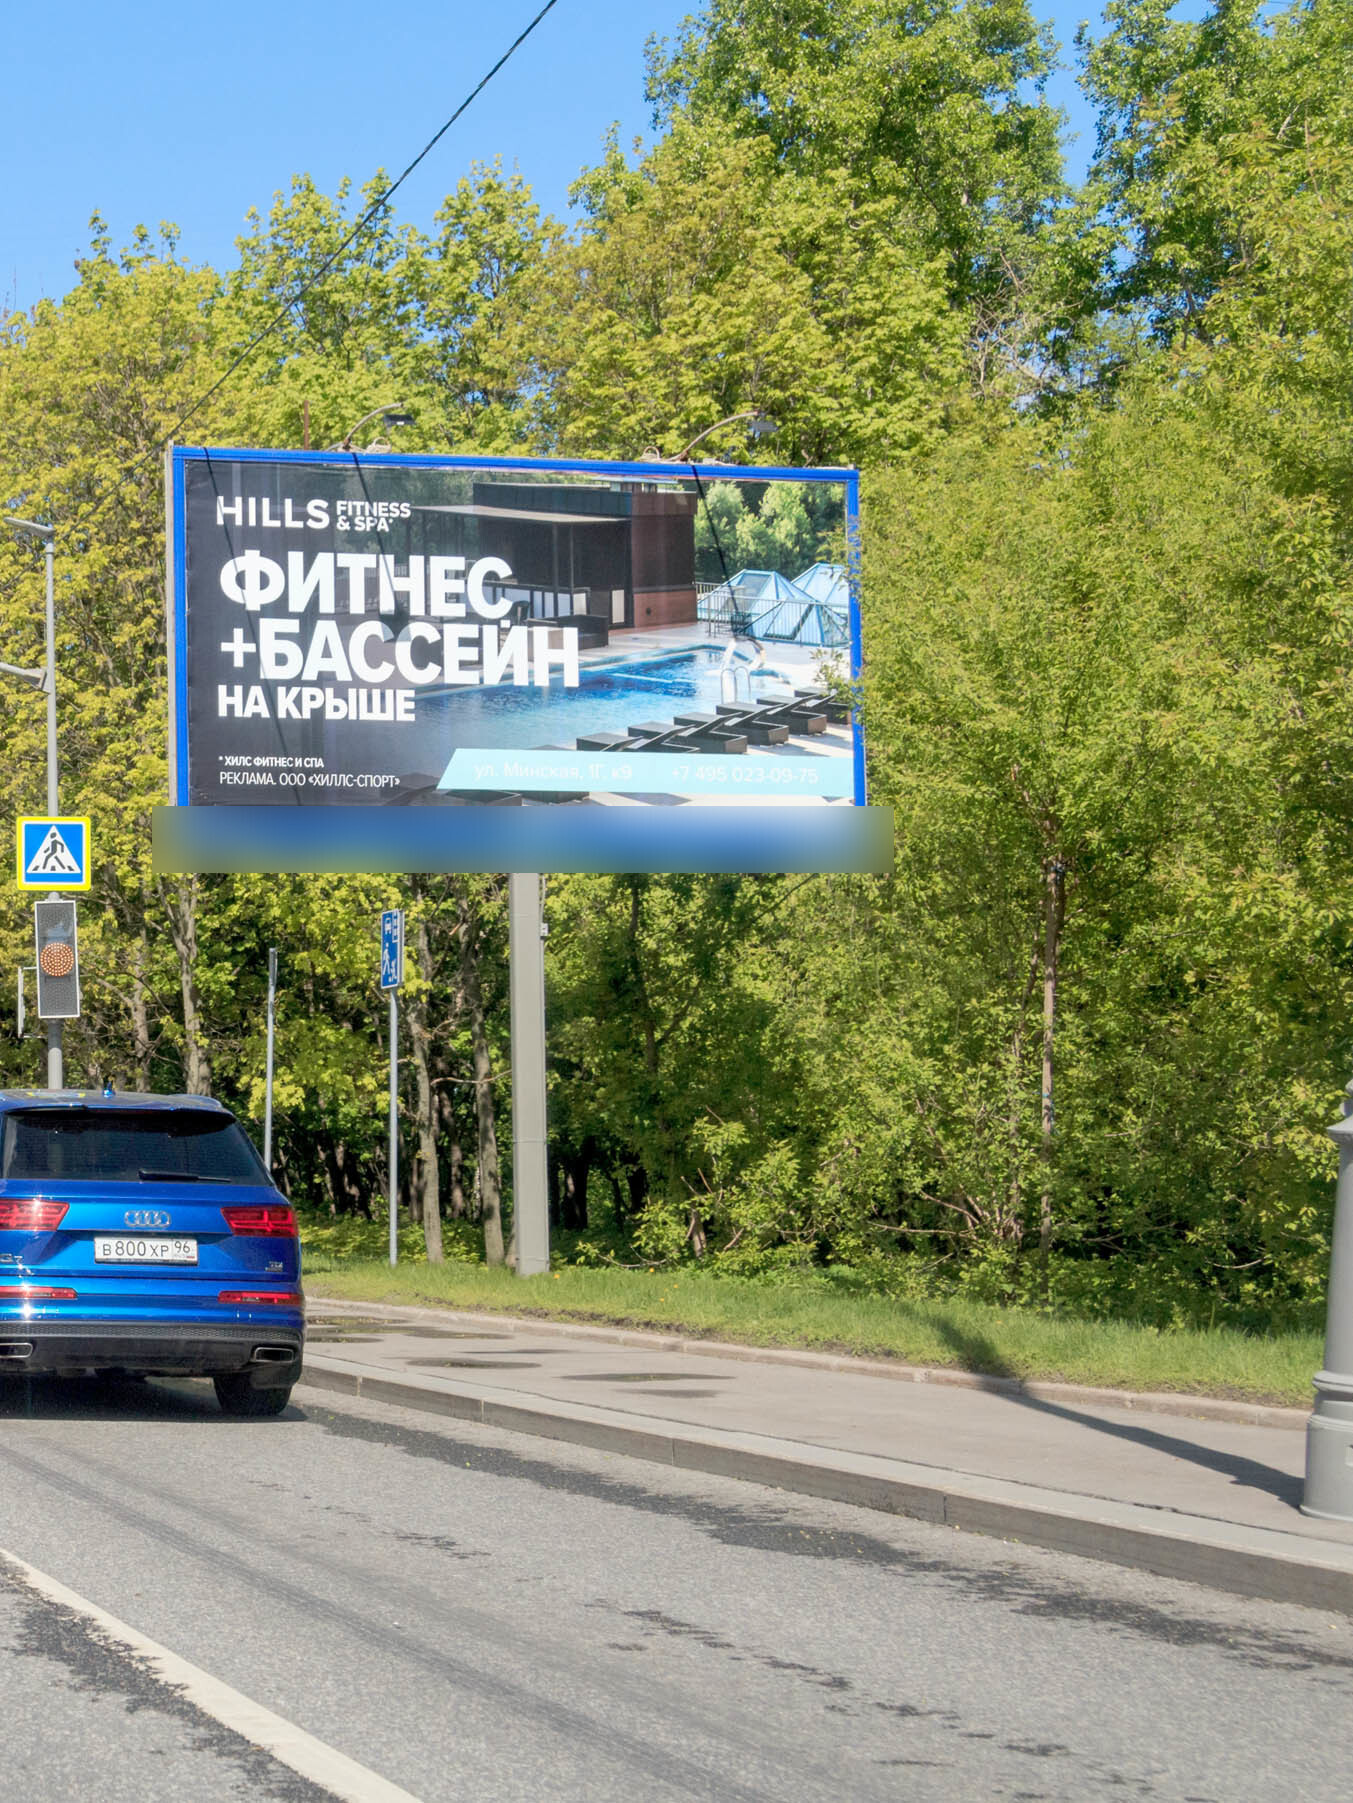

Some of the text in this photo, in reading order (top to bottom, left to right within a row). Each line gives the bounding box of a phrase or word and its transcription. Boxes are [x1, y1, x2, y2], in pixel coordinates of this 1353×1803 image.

[216, 495, 331, 530] HILLS
[336, 500, 412, 519] FITNESS
[336, 515, 351, 531] &
[219, 549, 514, 619] ФИТНЕС
[220, 617, 580, 688] +БАССЕЙН
[217, 684, 416, 722] НА КРЫШЕ
[224, 755, 253, 767] ХИЛС
[253, 756, 294, 768] ФИТНЕС
[295, 757, 303, 768] И
[304, 757, 325, 769] СПА
[473, 763, 499, 784] ул.
[503, 760, 584, 781] Минская,
[219, 772, 401, 788] РЕКЛАМА. ООО «ХИЛЛС-СПОРТ»
[672, 765, 690, 784] +7
[696, 766, 728, 784] 495
